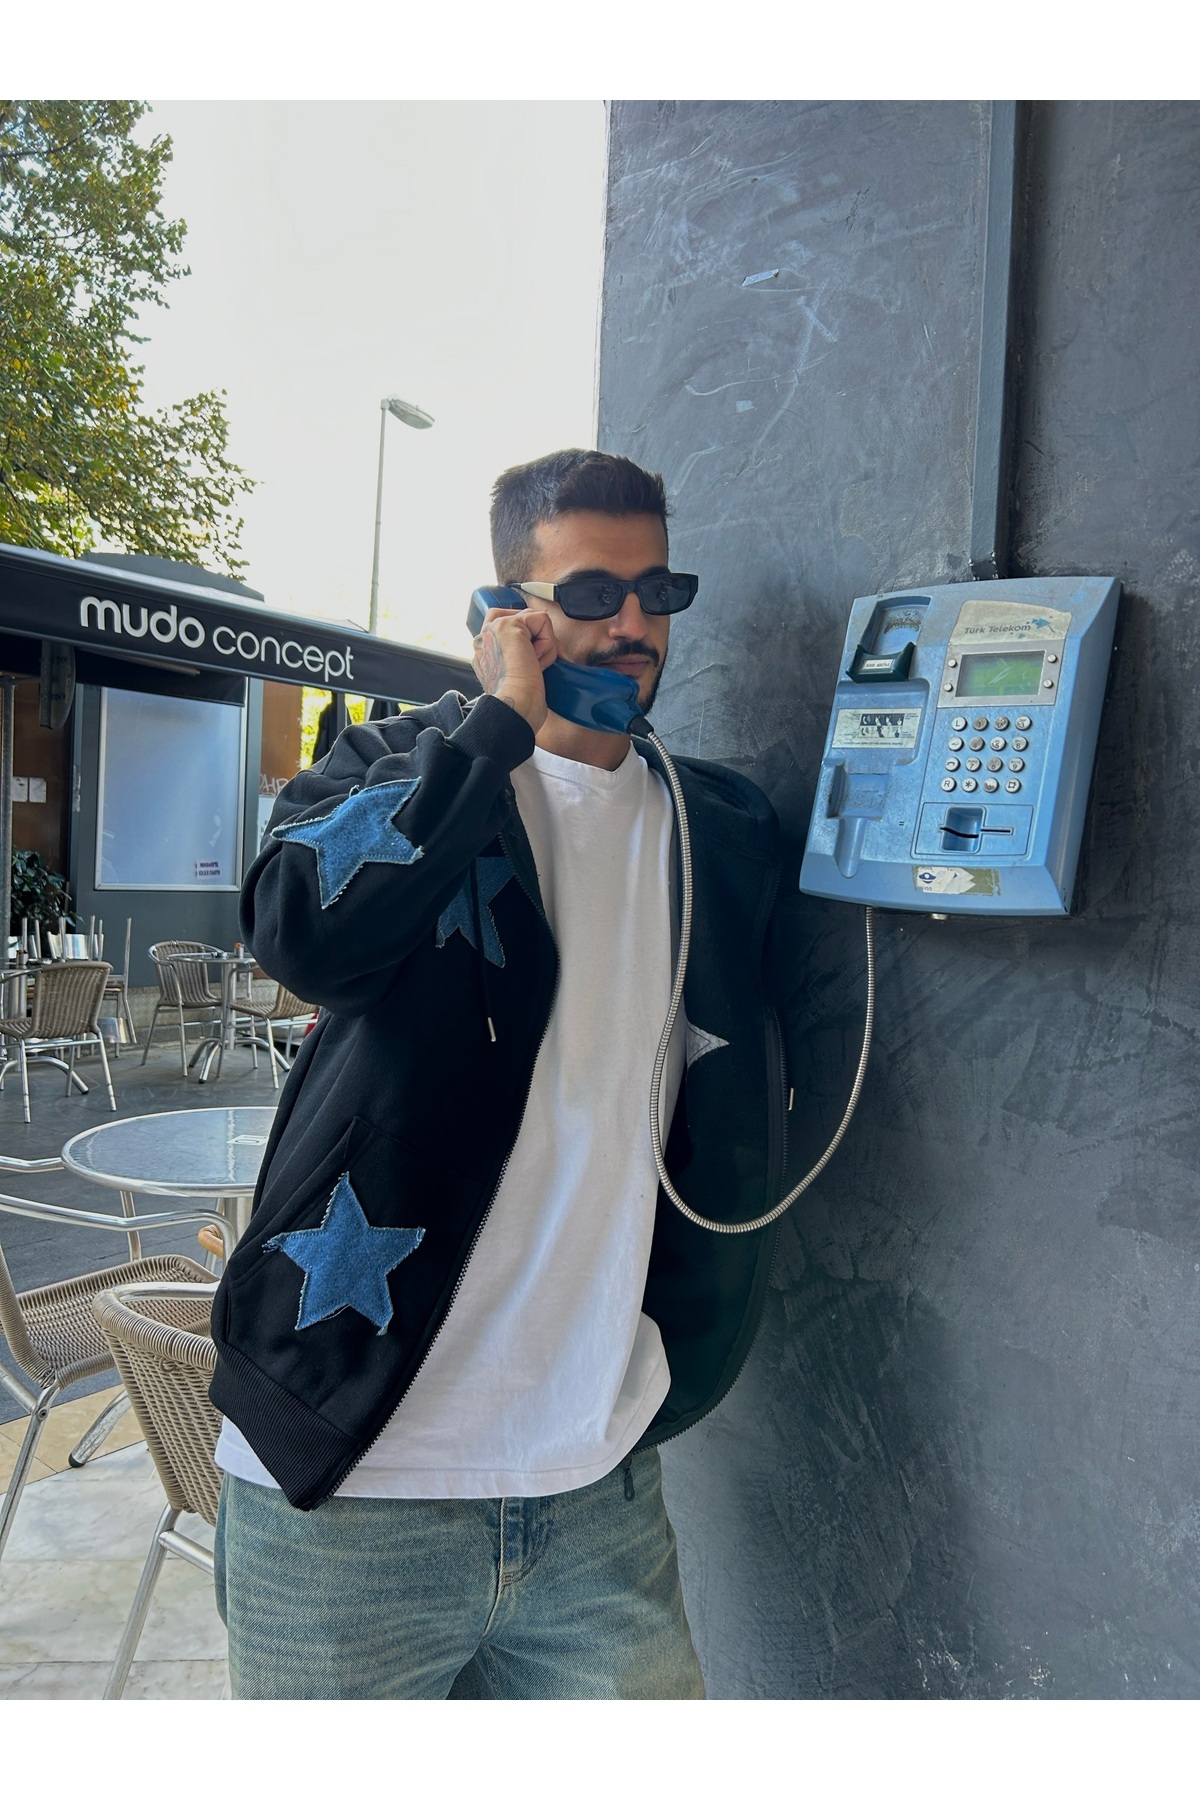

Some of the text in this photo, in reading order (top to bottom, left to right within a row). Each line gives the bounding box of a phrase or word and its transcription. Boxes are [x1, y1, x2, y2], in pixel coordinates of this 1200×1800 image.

[80, 596, 355, 683] mudo concept
[989, 624, 1031, 634] Telekom
